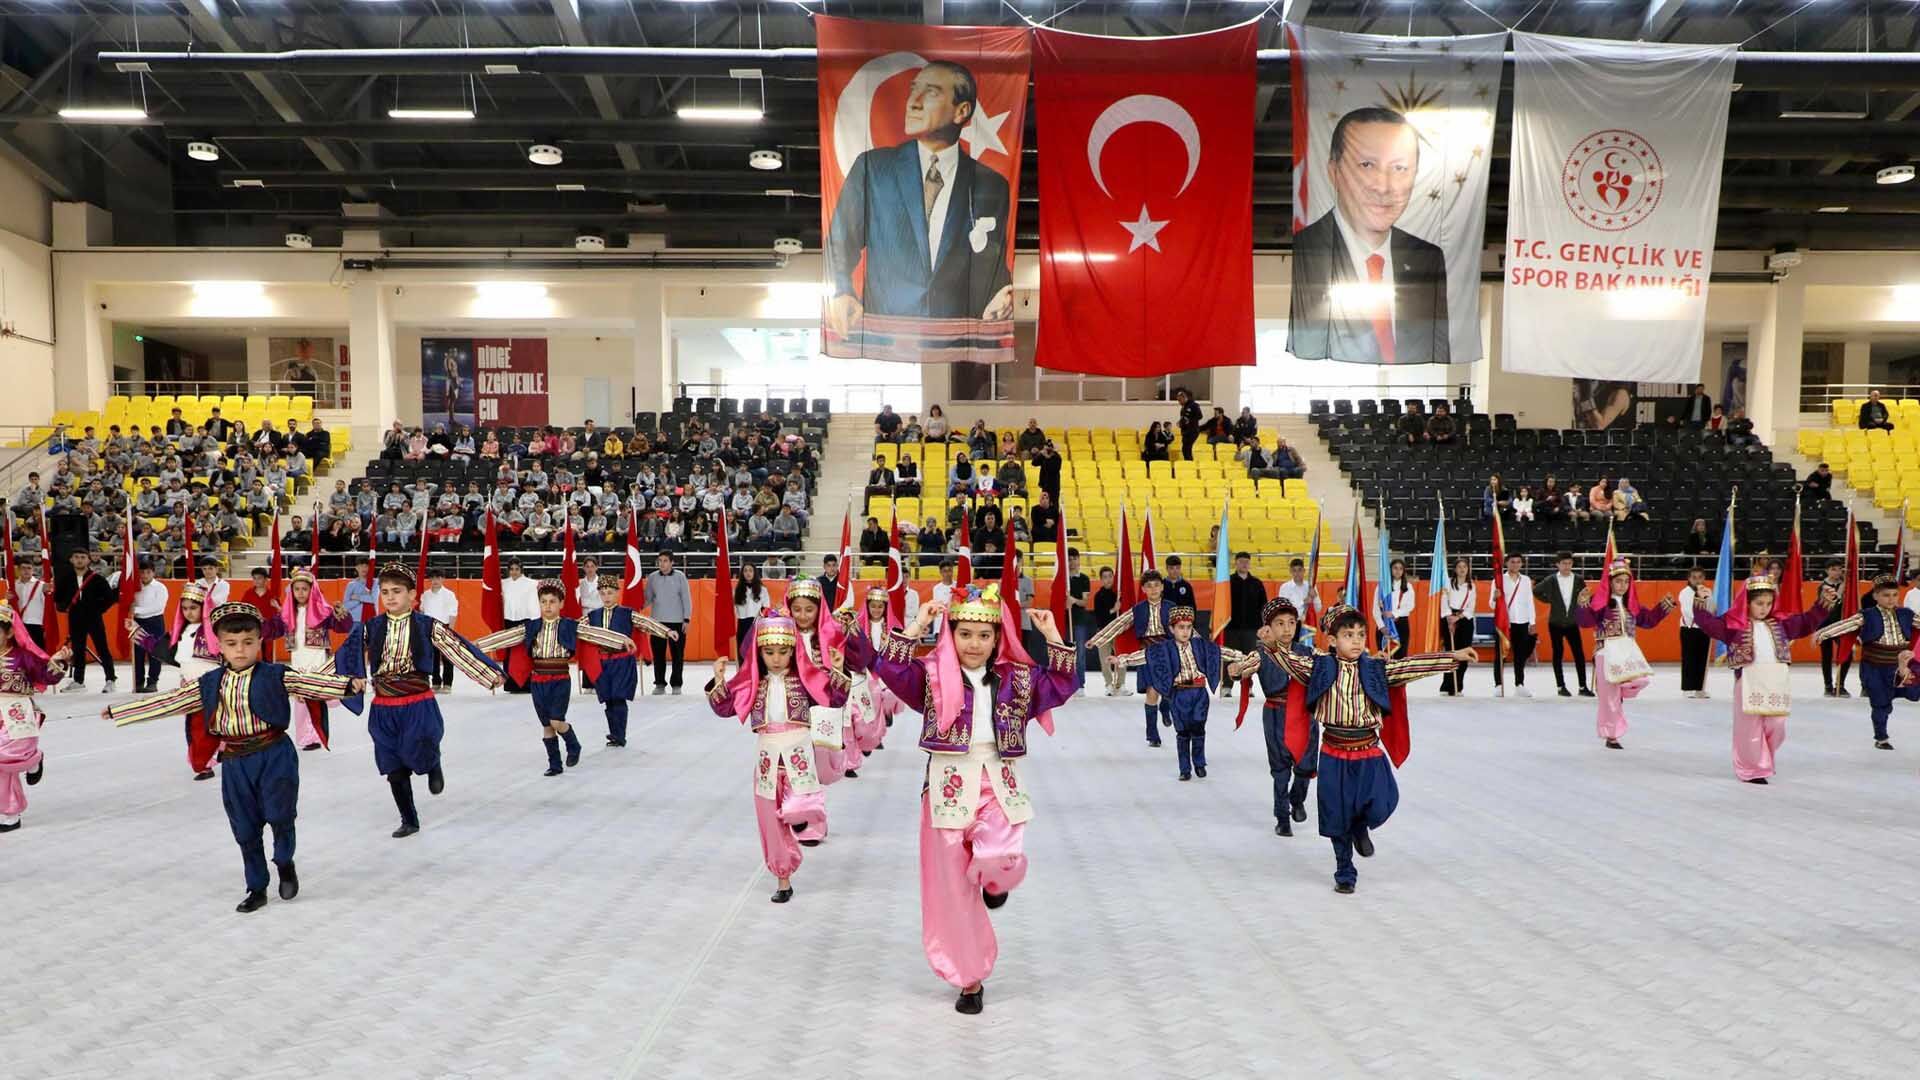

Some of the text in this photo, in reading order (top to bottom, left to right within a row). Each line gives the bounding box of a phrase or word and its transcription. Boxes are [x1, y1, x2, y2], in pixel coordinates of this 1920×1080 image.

[1514, 239, 1703, 269] T.C. GENÇLİK VE
[1511, 267, 1568, 288] SPOR
